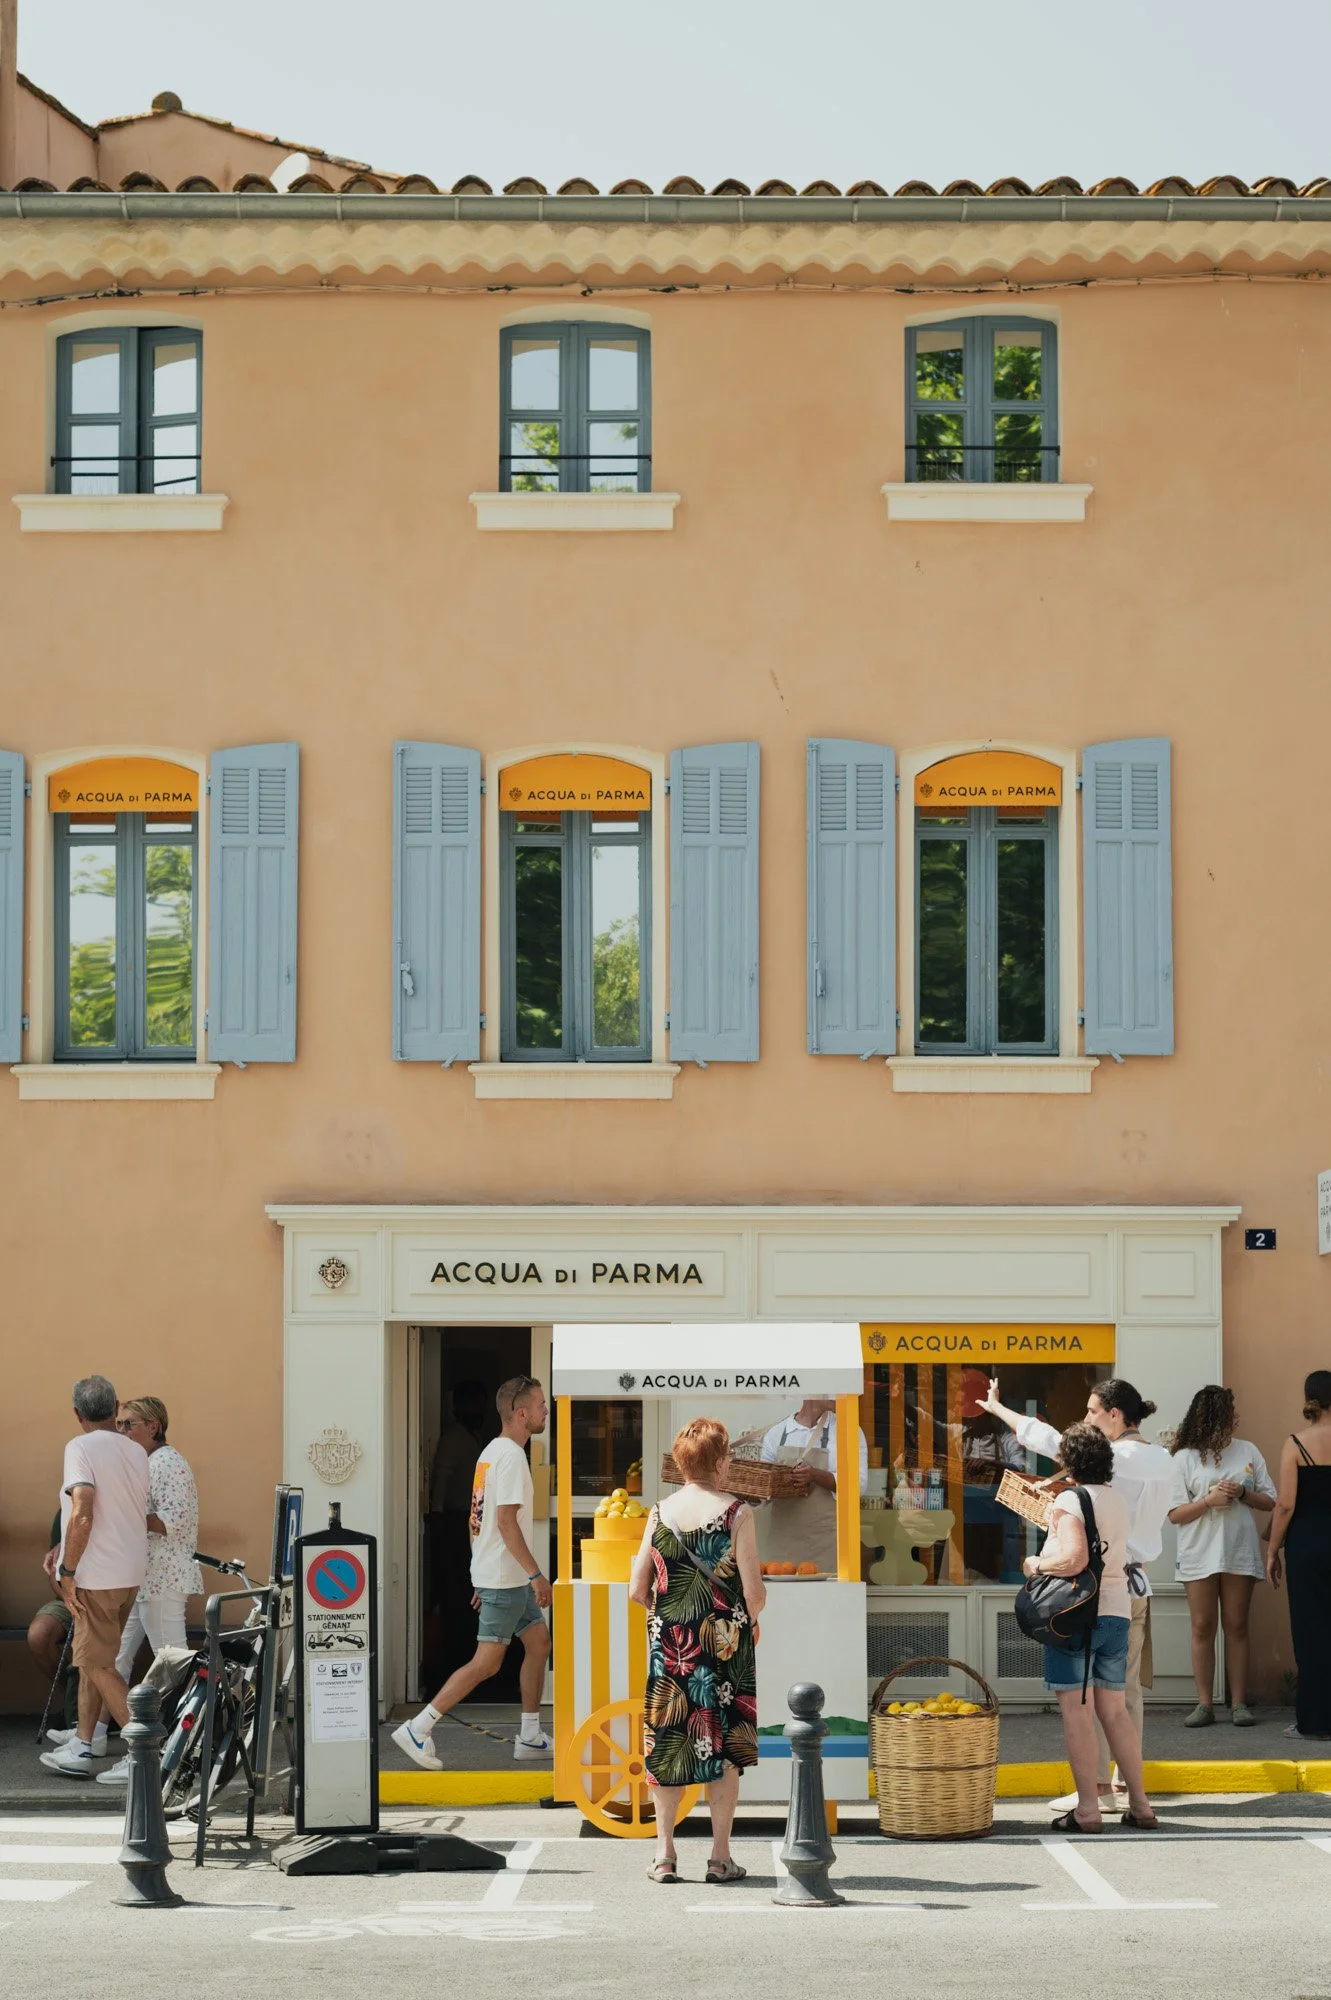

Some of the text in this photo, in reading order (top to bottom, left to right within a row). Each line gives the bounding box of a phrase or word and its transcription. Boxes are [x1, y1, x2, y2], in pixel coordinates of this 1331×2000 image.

[76, 792, 124, 803] ACQUA
[145, 792, 192, 802] PARMA
[527, 790, 576, 800] ACQUA
[596, 790, 645, 800] PARMA
[938, 786, 987, 797] ACQUA
[1008, 786, 1056, 796] PARMA
[1255, 1232, 1266, 1247] 2
[430, 1262, 703, 1285] ACQUA DI PARMA
[895, 1335, 1083, 1352] ACQUA DI PARMA
[642, 1375, 800, 1389] ACQUA DI PARMA
[286, 1509, 297, 1562] P
[307, 1613, 366, 1621] STATIONNEMENT
[322, 1621, 351, 1630] GÊNANT
